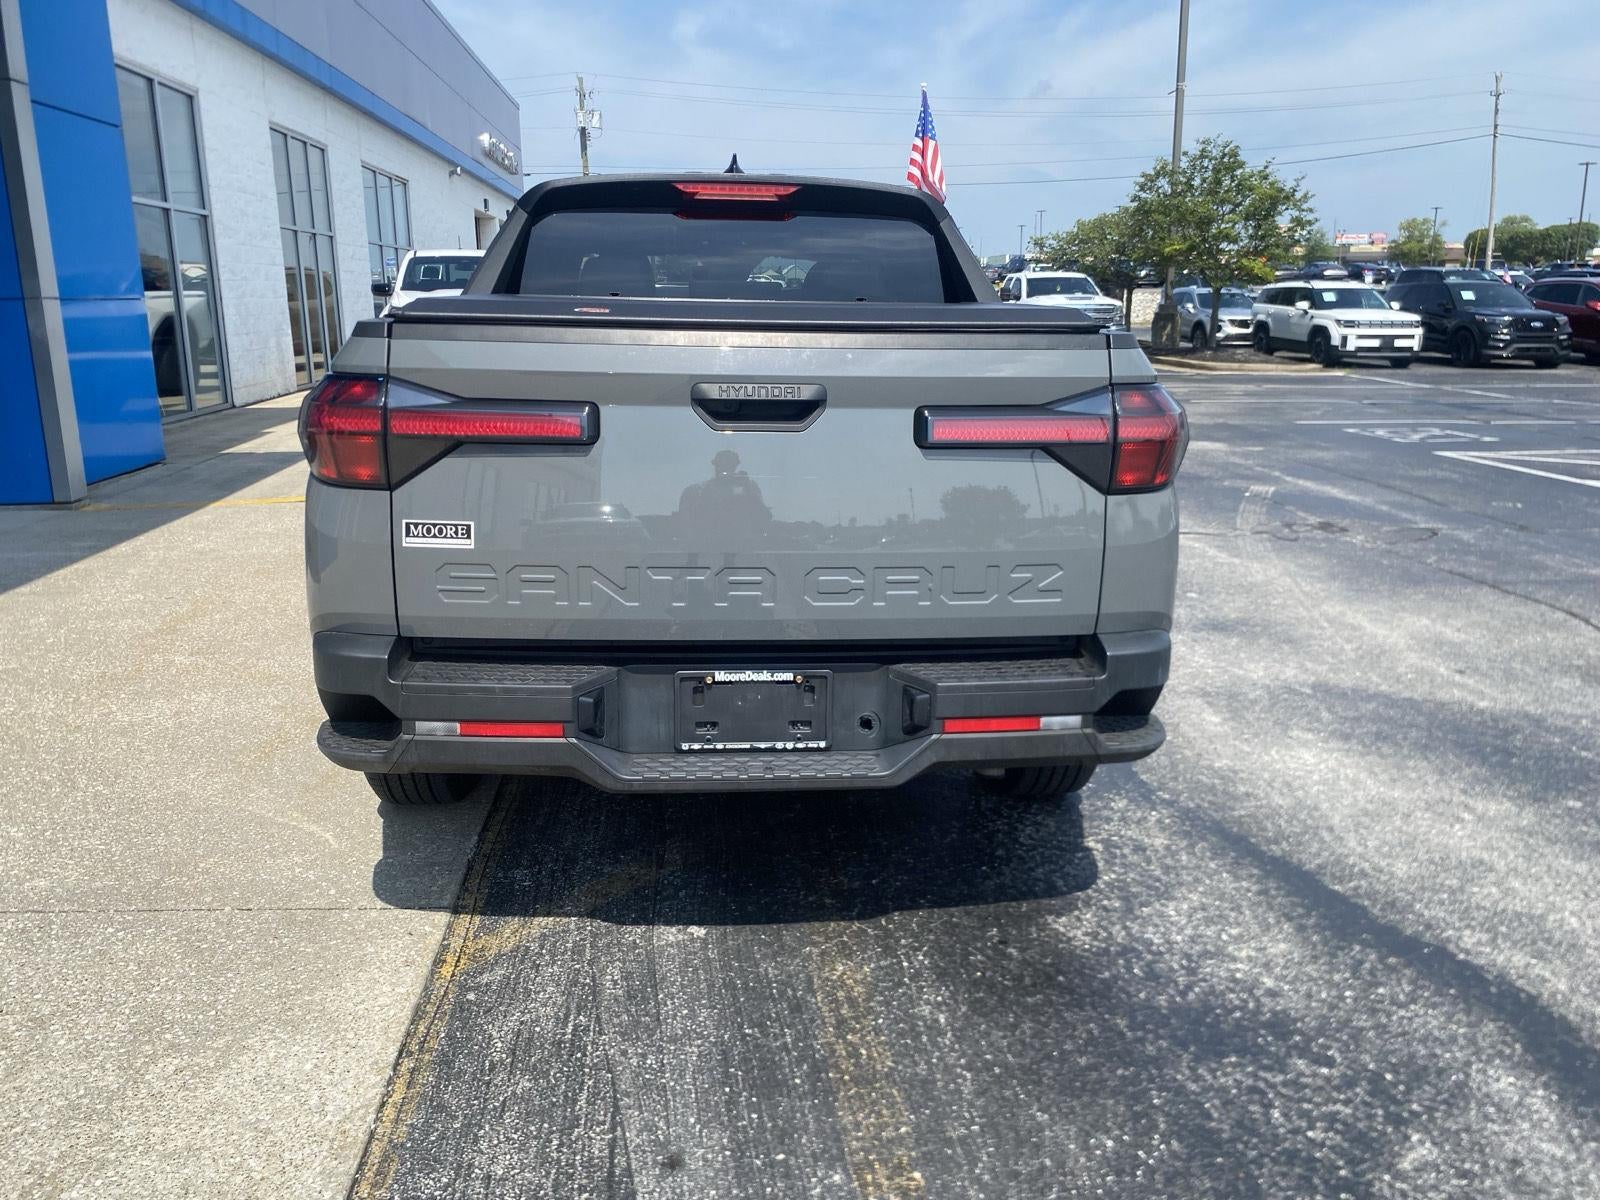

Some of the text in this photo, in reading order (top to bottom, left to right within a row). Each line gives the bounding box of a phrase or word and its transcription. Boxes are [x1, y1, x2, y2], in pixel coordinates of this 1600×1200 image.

[718, 385, 802, 399] HYUNDAI
[409, 524, 468, 538] MOORE
[434, 562, 1064, 606] SANTA CRUZ
[714, 670, 794, 682] MooreDeals.com
